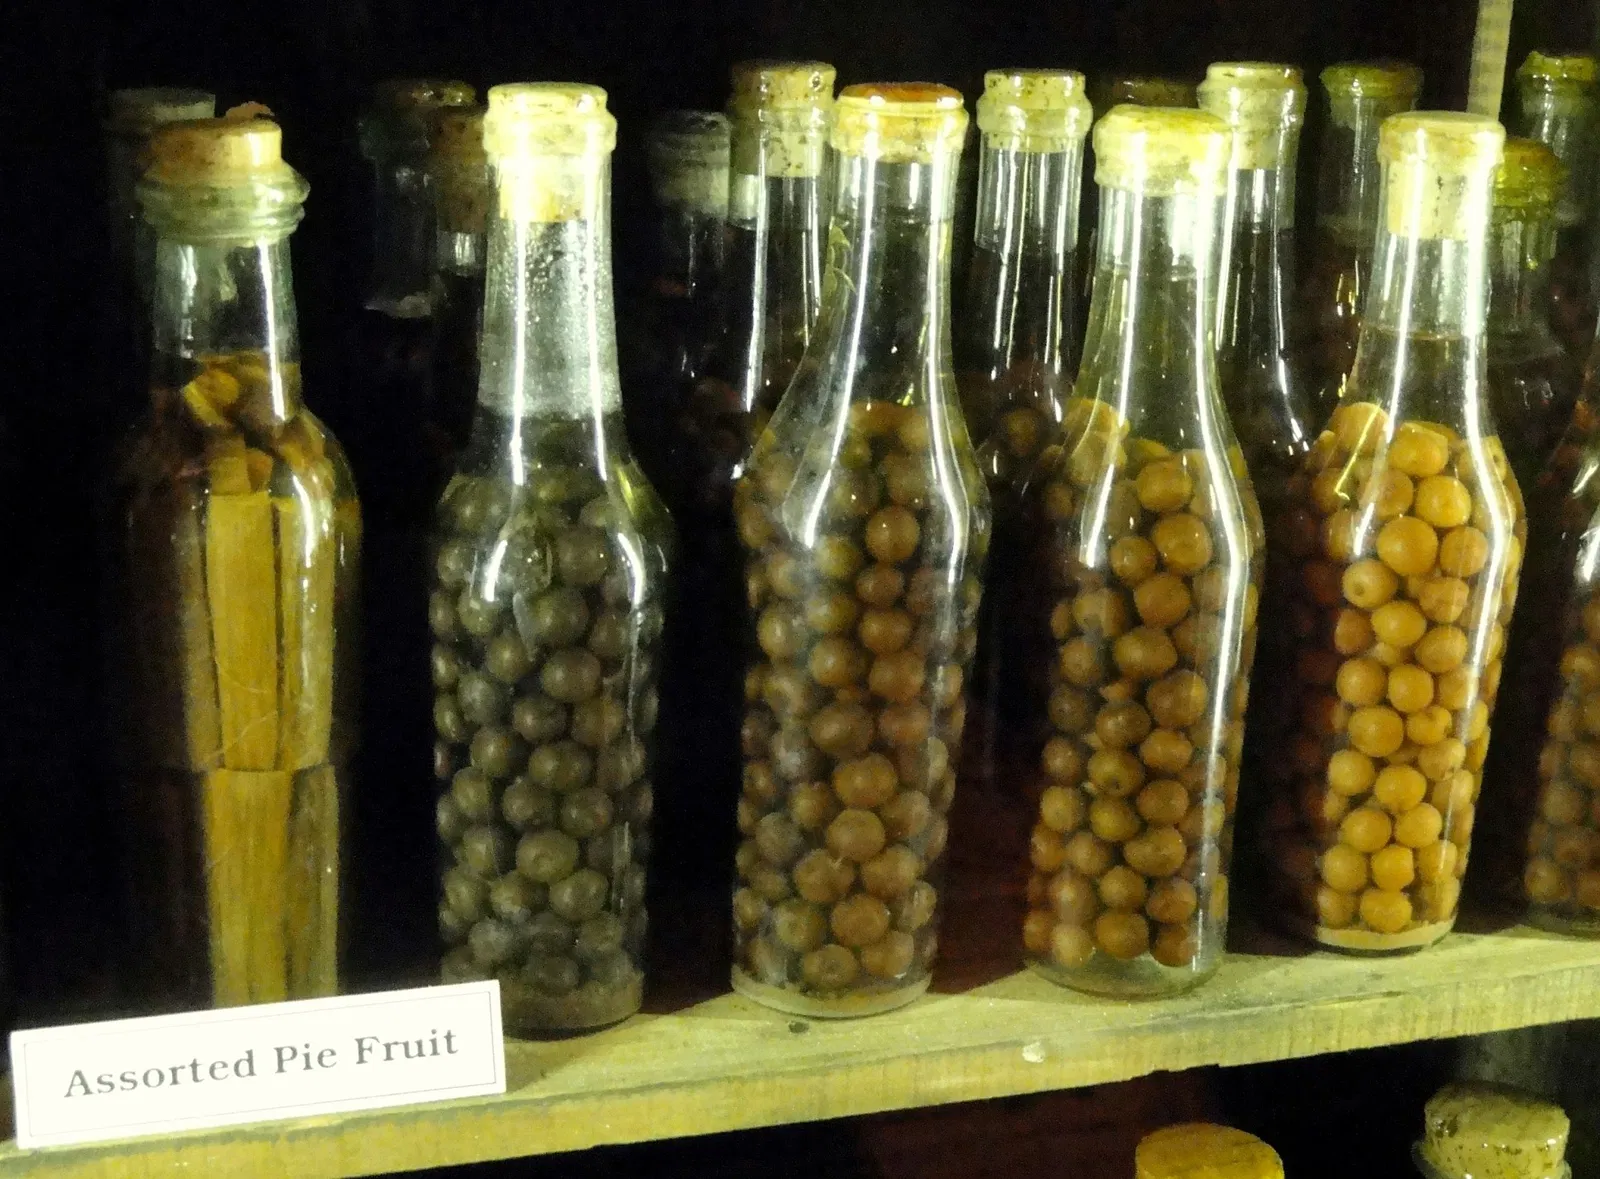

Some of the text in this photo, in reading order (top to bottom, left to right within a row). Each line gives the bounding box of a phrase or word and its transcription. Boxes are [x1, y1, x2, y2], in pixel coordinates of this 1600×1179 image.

[64, 1029, 459, 1098] Assorted Pie Fruit
